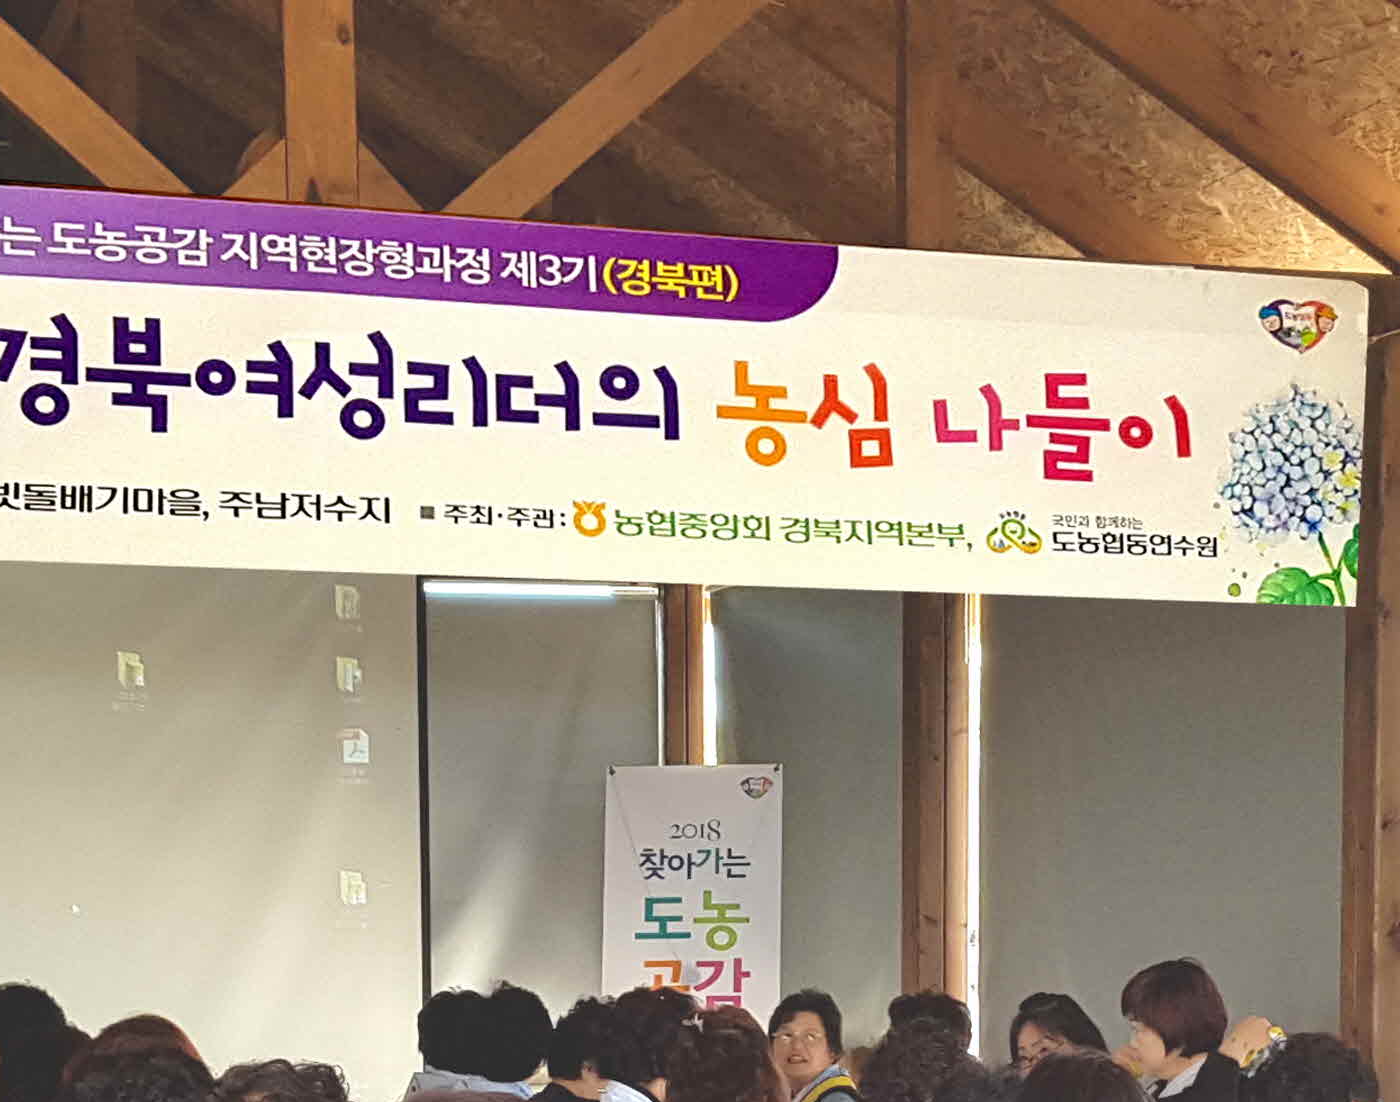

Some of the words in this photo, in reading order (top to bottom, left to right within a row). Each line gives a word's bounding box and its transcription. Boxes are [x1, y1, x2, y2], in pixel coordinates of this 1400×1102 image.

[46, 219, 214, 267] 도농공감
[220, 229, 492, 288] 지역현장형과정
[501, 250, 739, 303] 제3기(경북편)
[716, 361, 893, 468] 농심
[933, 373, 1191, 482] 나들이
[219, 491, 390, 523] 주남저수지
[1052, 514, 1090, 528] 국민과
[1095, 515, 1143, 530] 함께하는
[615, 510, 770, 541] 농협중앙회
[781, 517, 972, 551] 경북지역본부,
[1052, 531, 1218, 558] 도농협동연수원
[669, 818, 721, 842] 2018
[639, 847, 751, 880] 찾아가는
[634, 889, 750, 951] 도농
